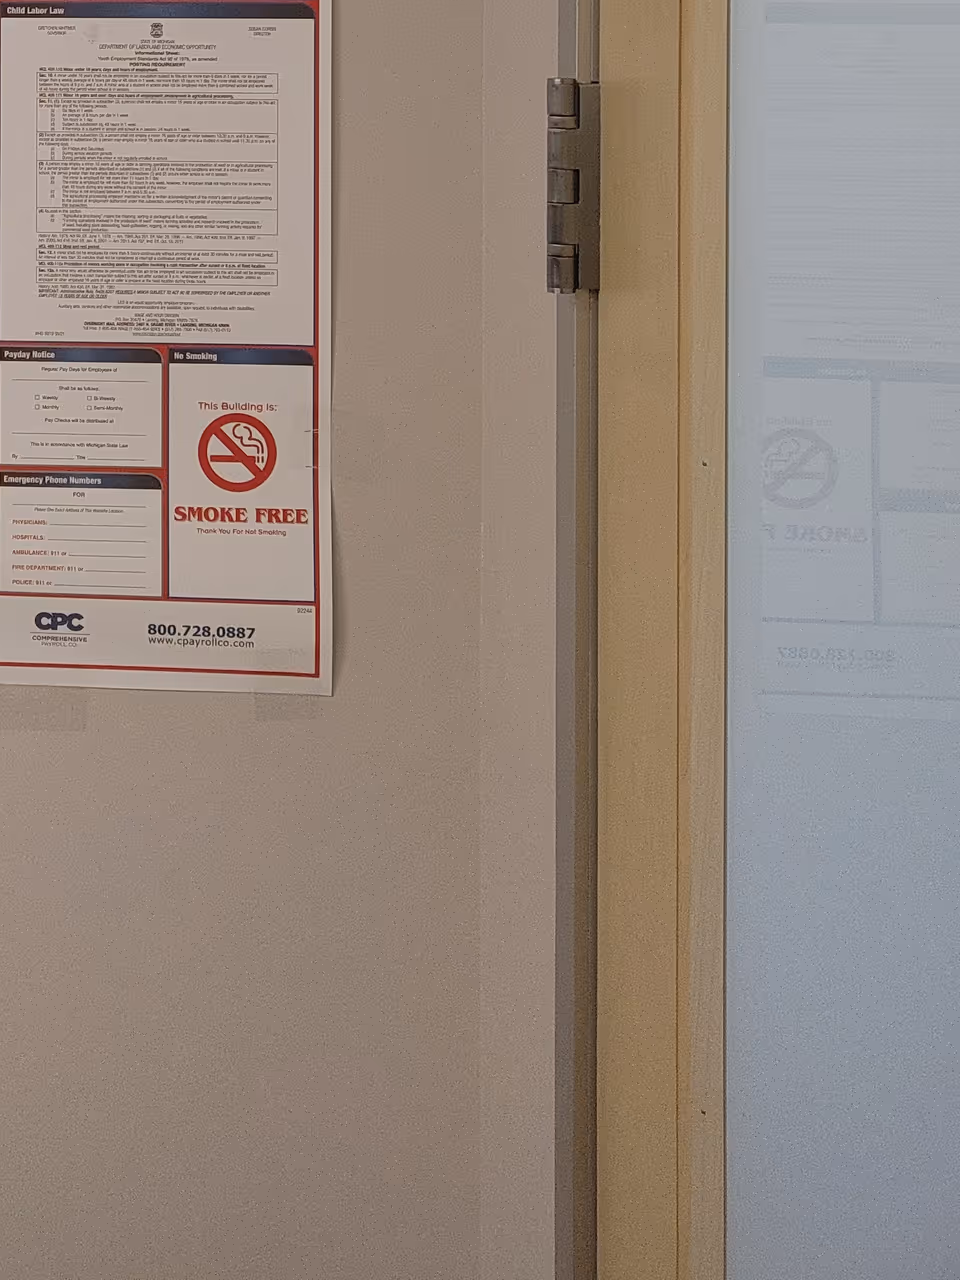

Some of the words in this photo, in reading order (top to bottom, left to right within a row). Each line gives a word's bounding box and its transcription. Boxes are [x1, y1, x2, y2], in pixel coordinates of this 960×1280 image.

[4, 351, 30, 359] Payday
[186, 352, 218, 362] Smoking
[199, 402, 218, 410] This
[221, 402, 264, 413] Building
[3, 477, 44, 485] Emergency
[45, 476, 68, 484] Phone
[174, 506, 248, 523] SMOKE
[255, 508, 308, 524] FREE
[35, 612, 83, 631] CPC
[148, 625, 255, 638] 800.728.0887
[149, 638, 255, 648] www.cpayrollco.com
